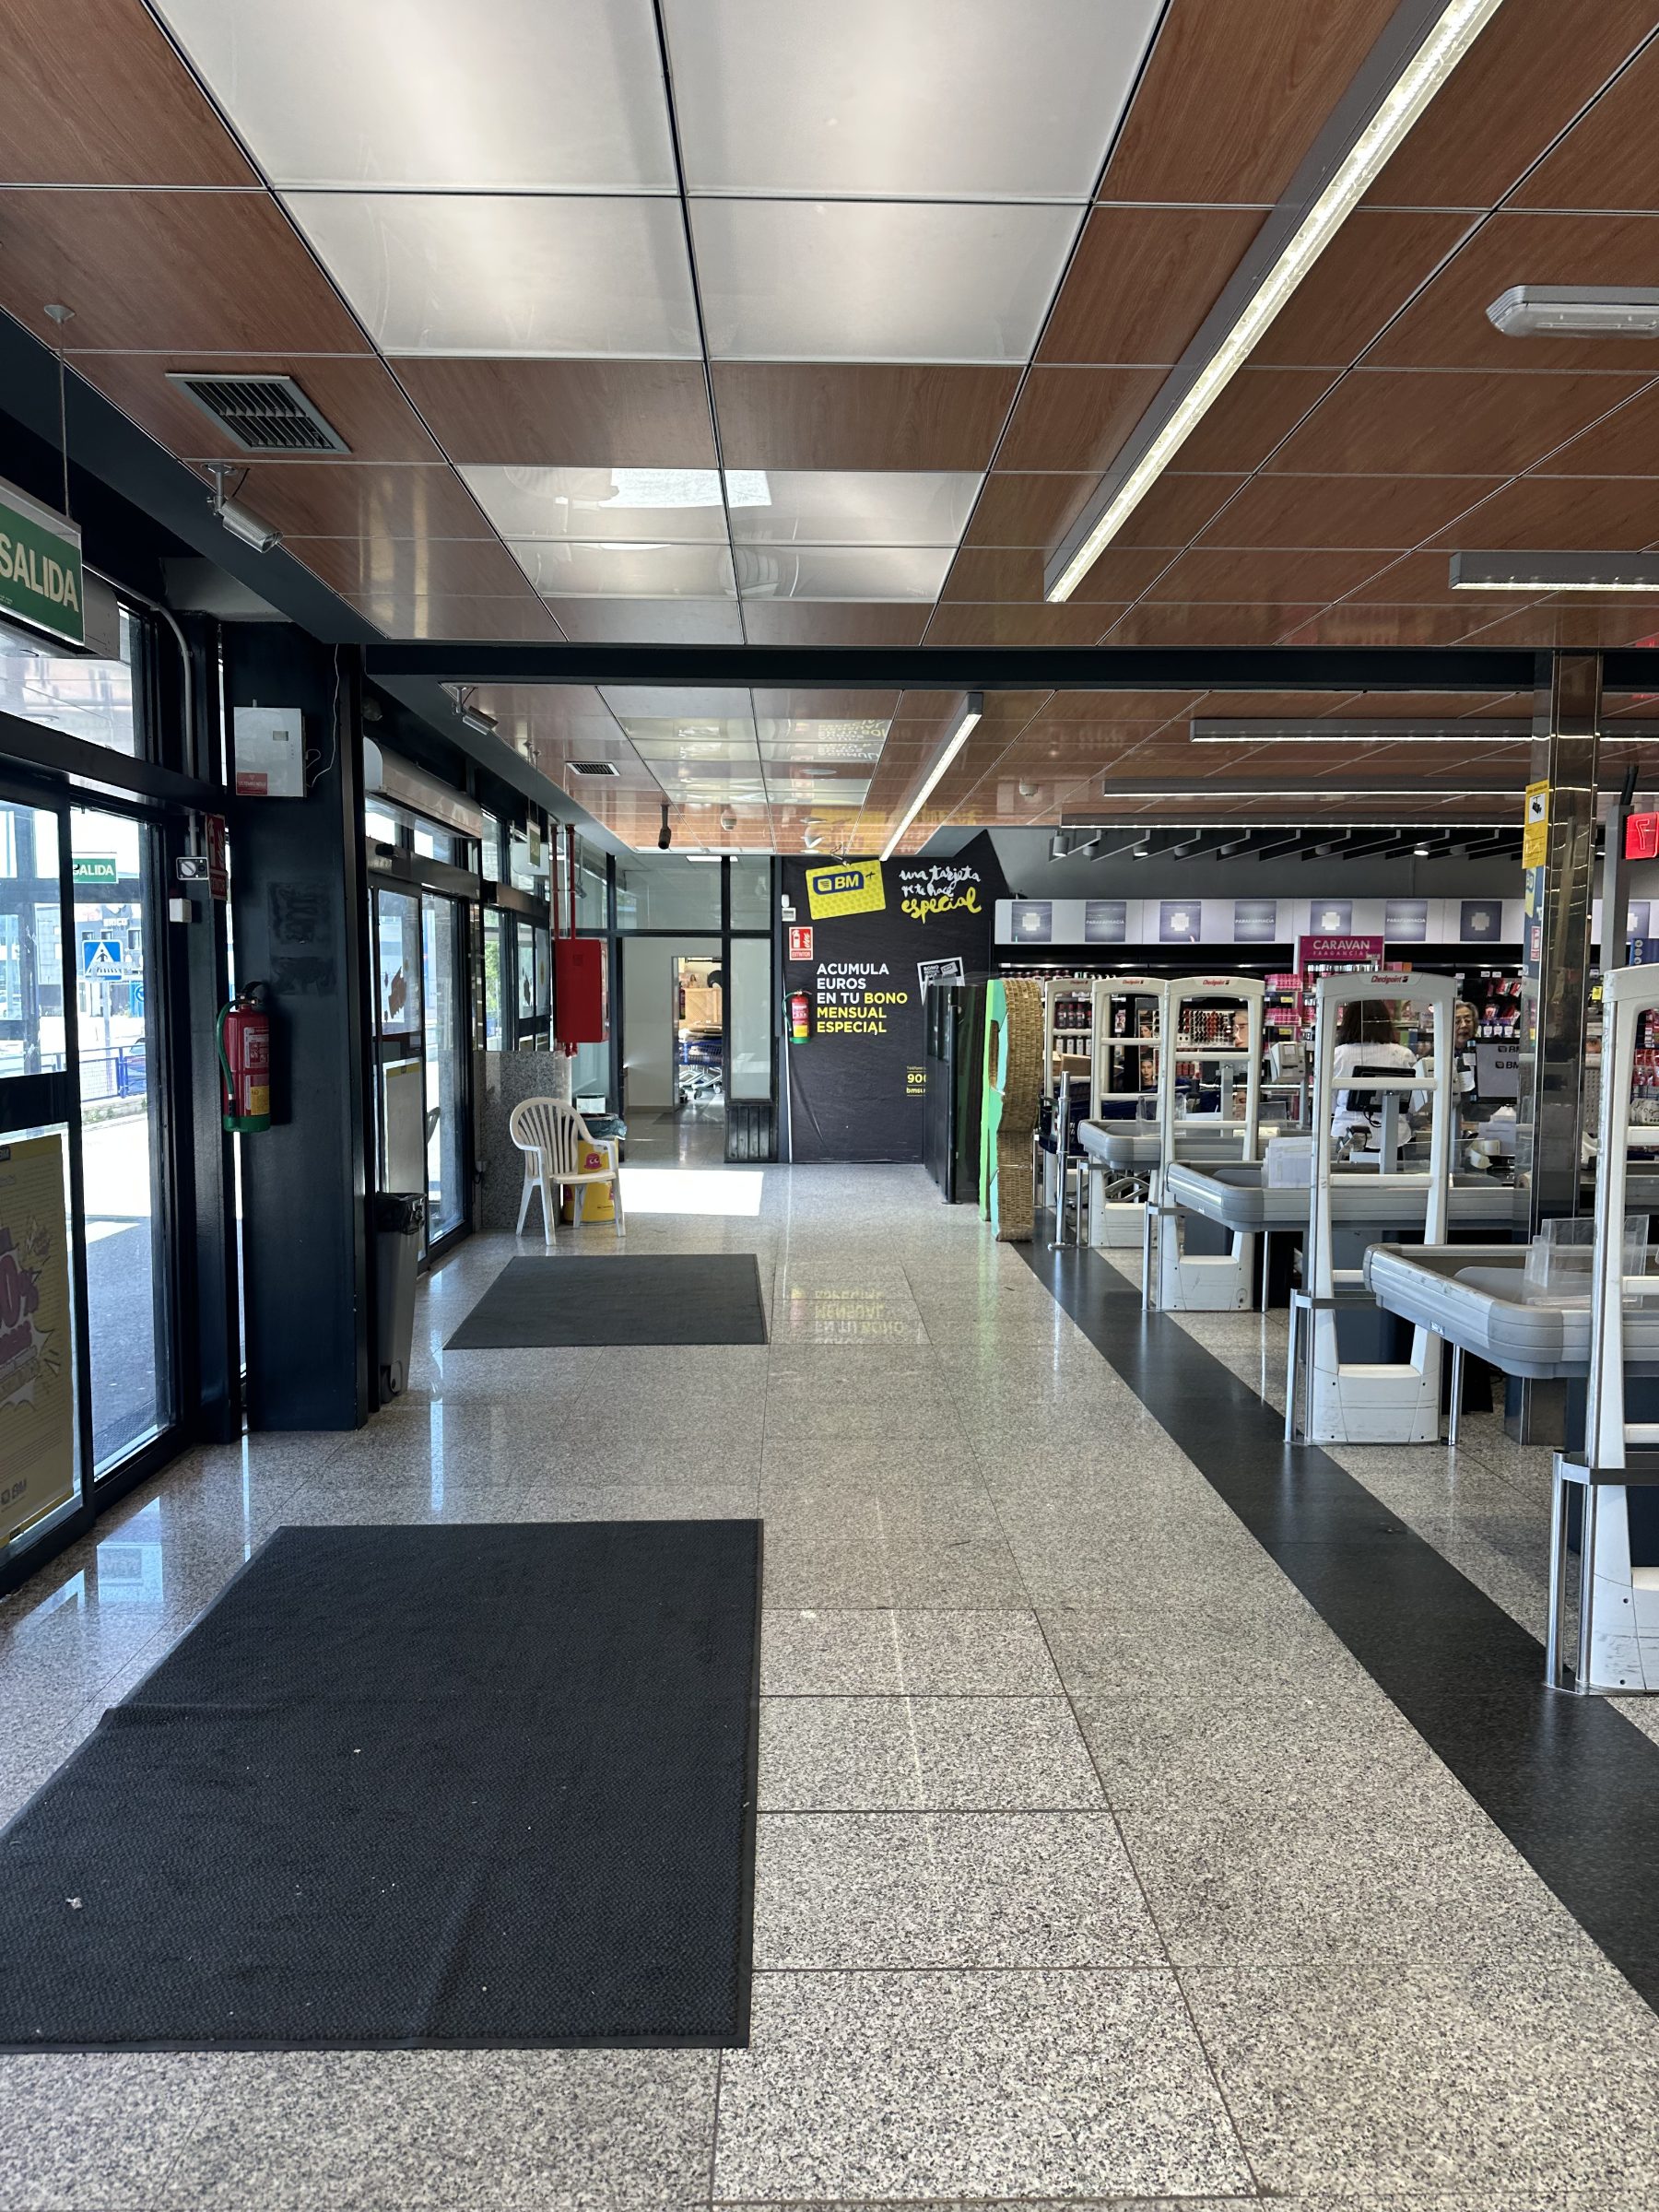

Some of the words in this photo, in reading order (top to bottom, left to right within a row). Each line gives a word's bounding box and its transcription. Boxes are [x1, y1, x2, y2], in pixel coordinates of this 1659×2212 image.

[0, 532, 79, 613] SALIDA
[834, 874, 859, 890] BM
[899, 870, 928, 881] una
[929, 865, 981, 890] tarjeta
[901, 887, 982, 924] especial
[1312, 940, 1371, 950] CARAVAN
[817, 963, 889, 975] ACUMULA
[817, 978, 866, 990] EUROS
[1371, 975, 1402, 984] Checkpoint
[817, 992, 837, 1005] EN
[841, 992, 860, 1005] TU
[864, 992, 908, 1005] BONO
[817, 1006, 887, 1018] MENSUAL
[817, 1021, 887, 1033] ESPECIAL
